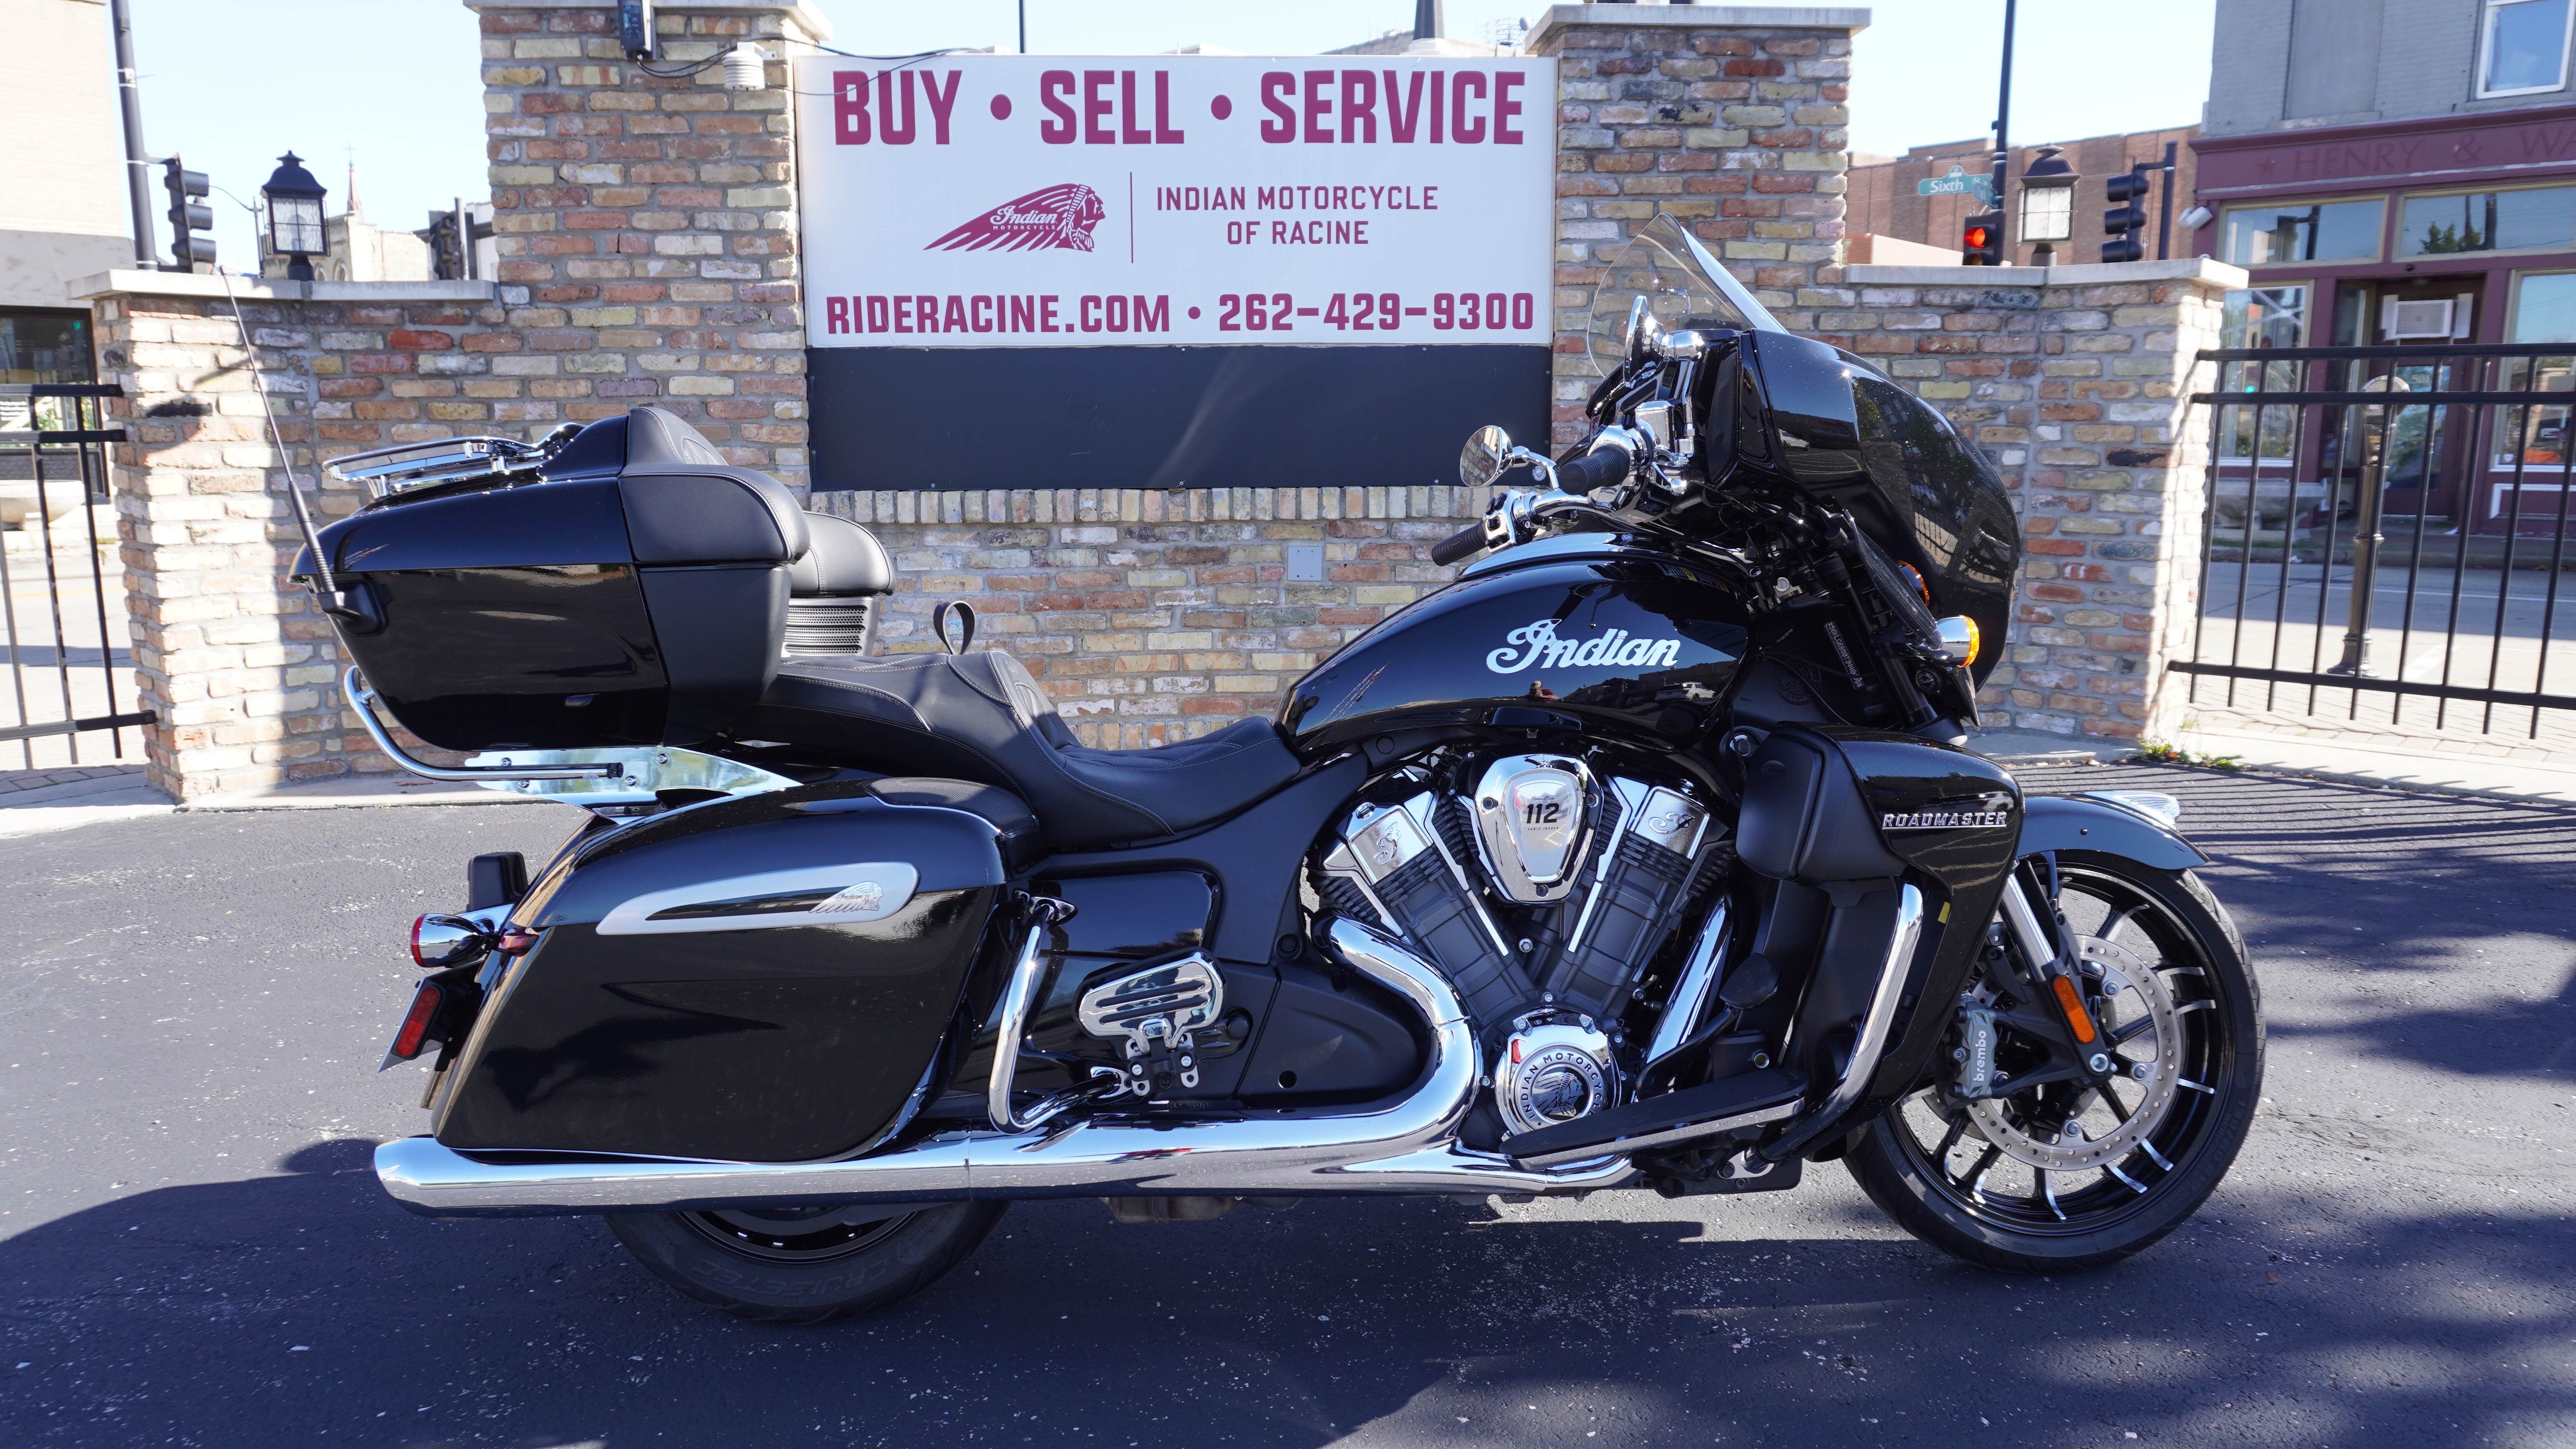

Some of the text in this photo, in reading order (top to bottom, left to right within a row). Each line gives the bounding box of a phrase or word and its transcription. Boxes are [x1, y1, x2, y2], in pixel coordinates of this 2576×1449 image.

[833, 70, 1525, 146] BUY SELL SERVICE
[2294, 139, 2423, 175] HENRY
[2454, 134, 2482, 163] &
[1157, 185, 1438, 211] INDIAN MOTORCYCLE
[1930, 179, 1964, 193] Sixth
[990, 205, 1058, 225] Indian
[1227, 220, 1369, 245] OF RACINE
[826, 292, 1534, 334] RIDERACINE.COM 262-429-9300
[1486, 618, 1681, 674] Indian
[1526, 803, 1560, 824] 112
[1882, 811, 2007, 828] ROADMASTER
[1973, 1030, 1987, 1082] brembo
[1521, 1065, 1539, 1119] INDIAN
[693, 1258, 889, 1297] CRUISETEC
